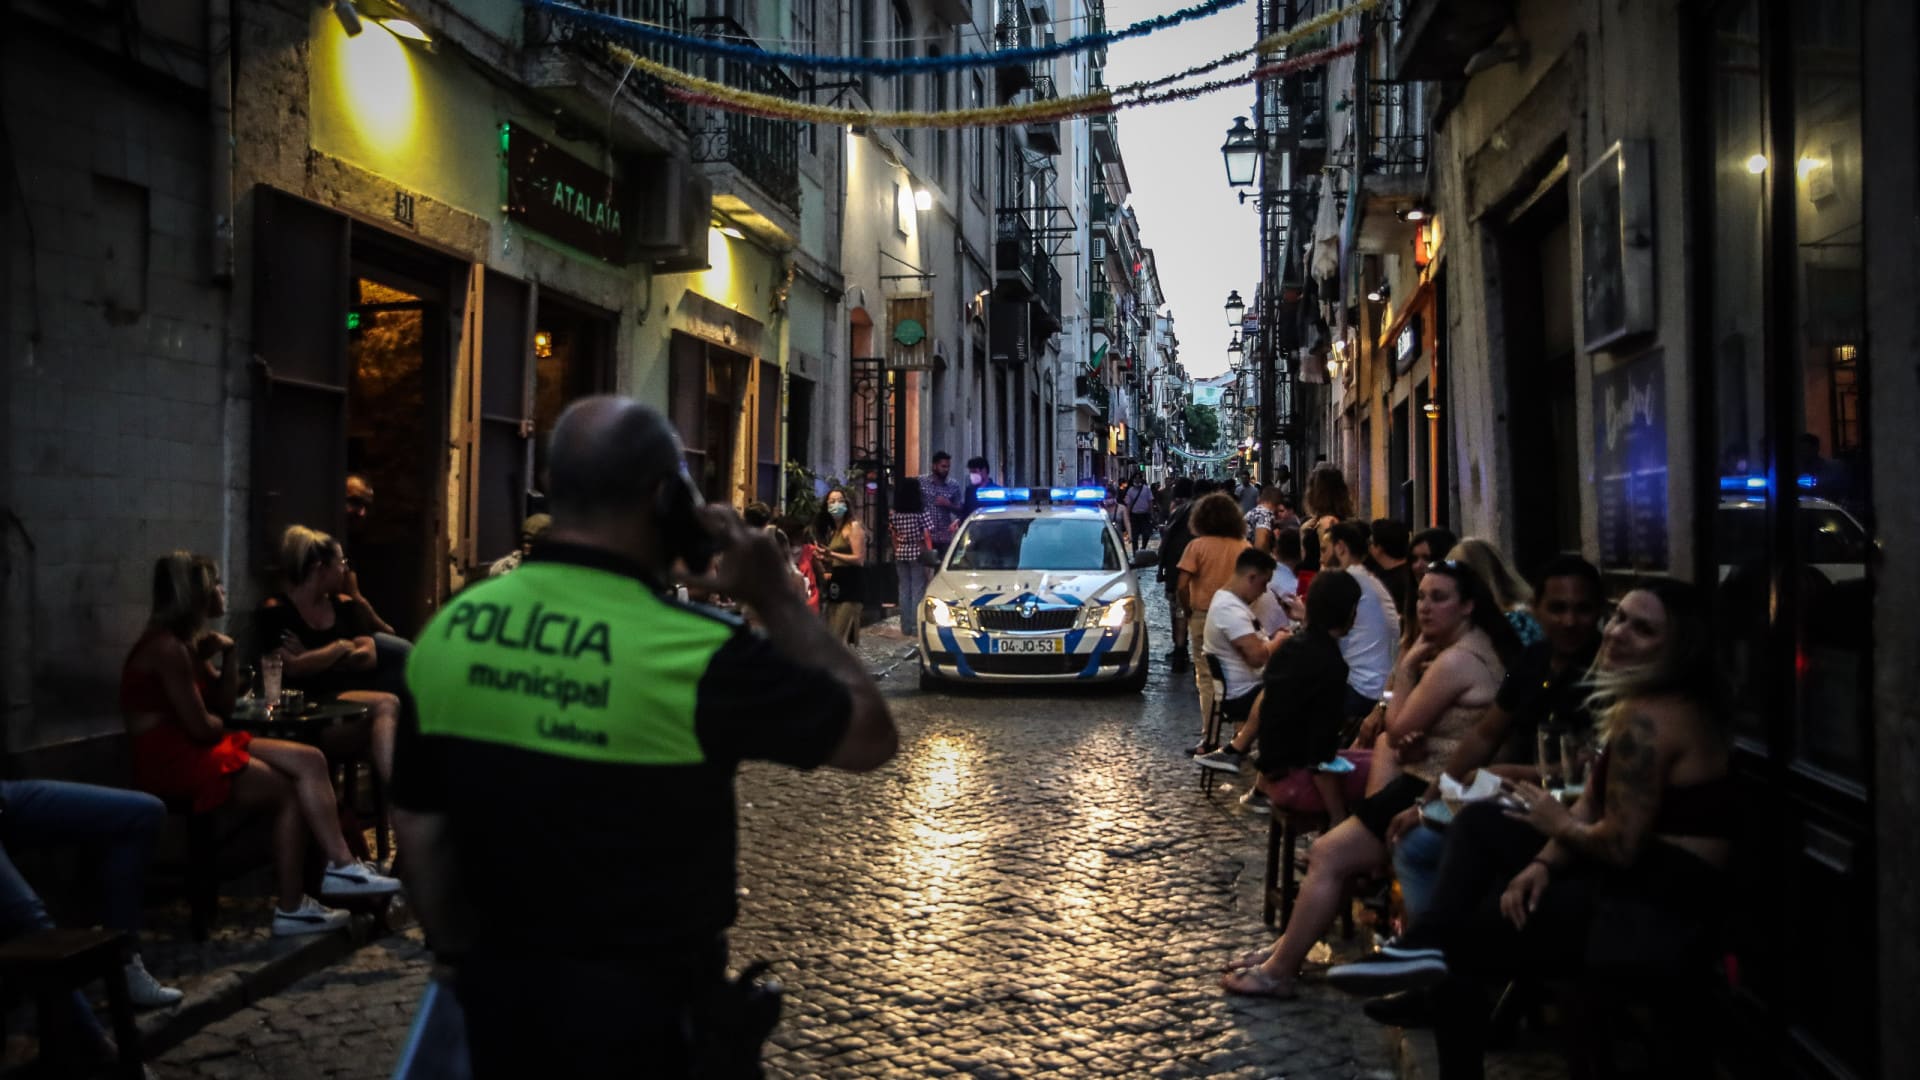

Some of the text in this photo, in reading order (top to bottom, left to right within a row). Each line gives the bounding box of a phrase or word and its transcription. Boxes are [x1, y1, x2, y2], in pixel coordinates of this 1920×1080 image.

[399, 193, 411, 220] 51
[552, 179, 622, 236] ATALAIA
[446, 601, 611, 664] POLÍCIA
[469, 663, 610, 709] municipal
